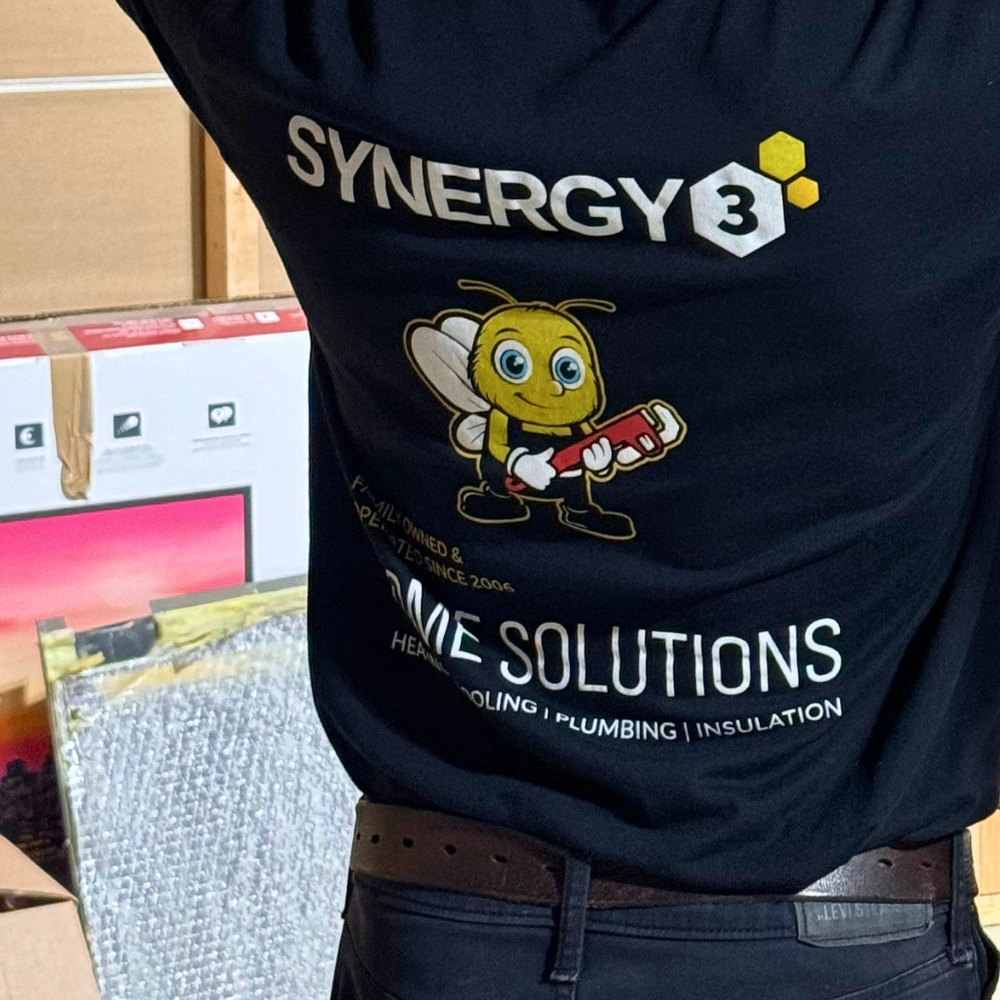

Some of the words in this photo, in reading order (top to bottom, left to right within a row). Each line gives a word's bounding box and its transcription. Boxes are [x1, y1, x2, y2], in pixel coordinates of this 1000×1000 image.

[287, 114, 685, 242] SYNERGY
[716, 184, 759, 236] 3
[403, 517, 447, 558] OWNED
[424, 556, 469, 586] SINCE
[499, 617, 843, 698] SOLUTIONS
[556, 713, 677, 741] PLUMBING
[697, 697, 843, 739] INSULATION
